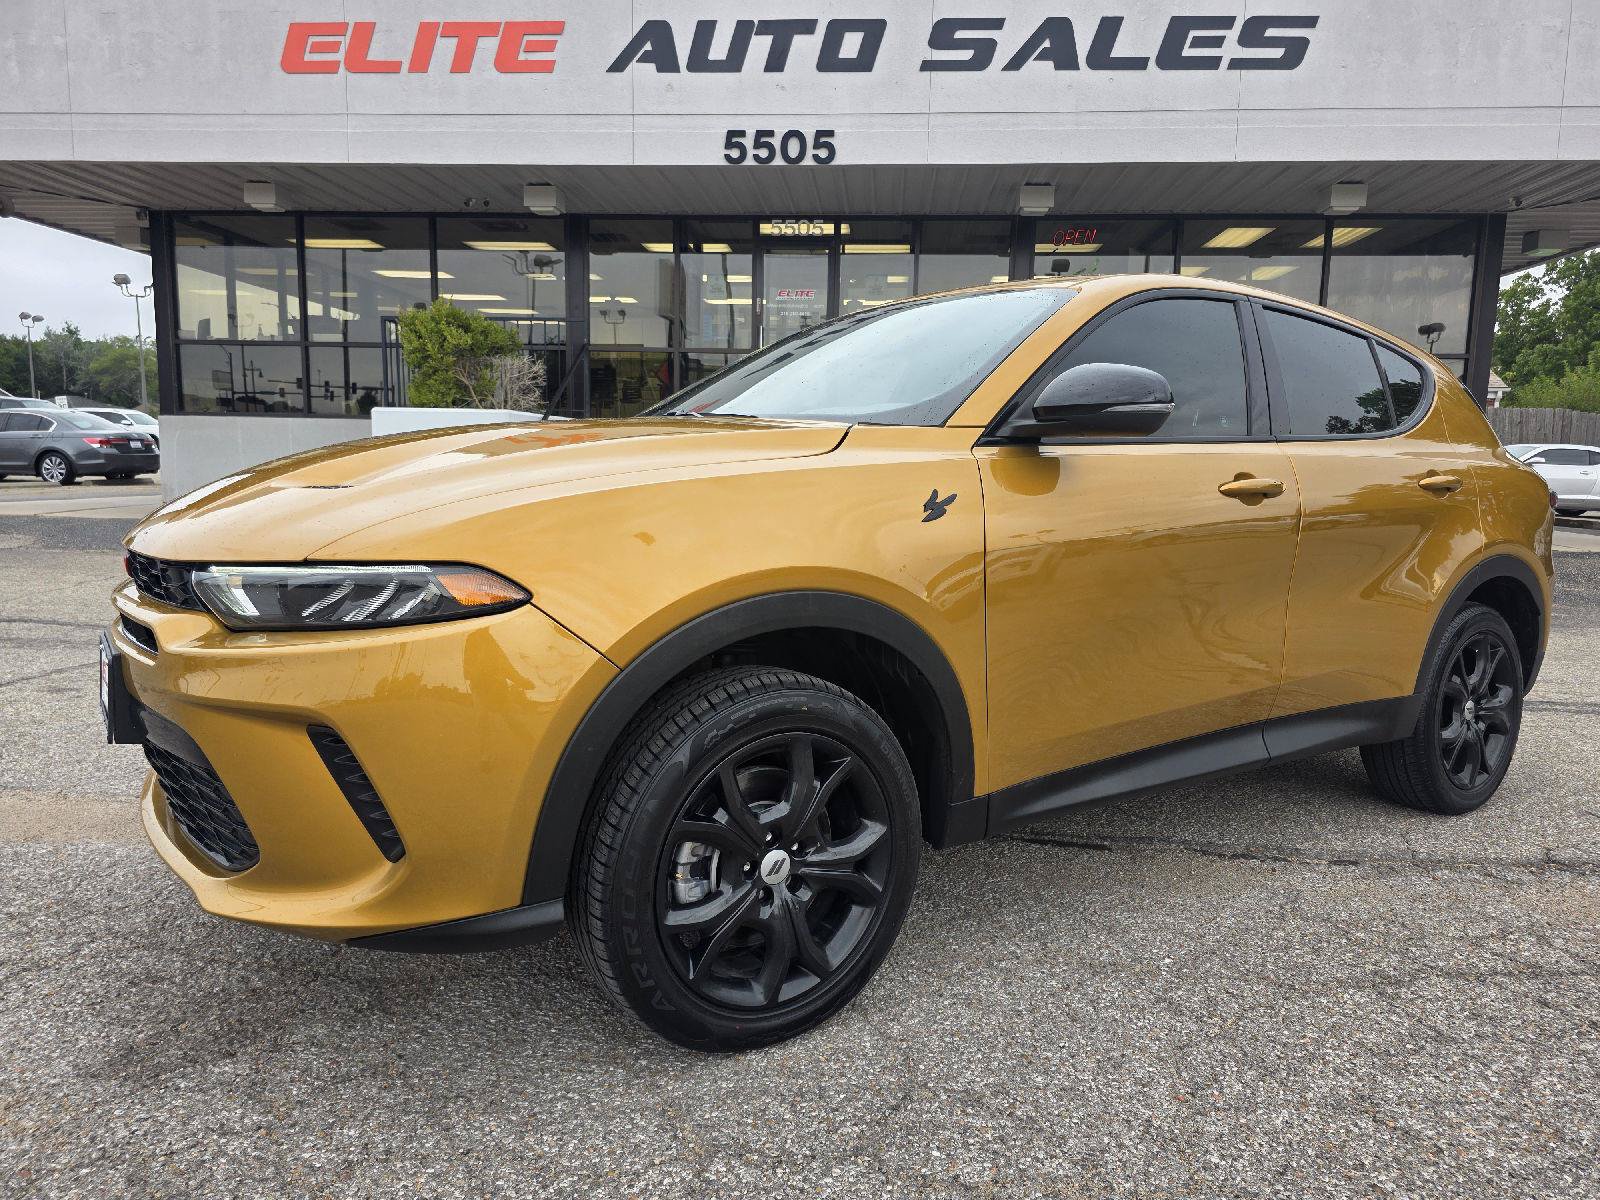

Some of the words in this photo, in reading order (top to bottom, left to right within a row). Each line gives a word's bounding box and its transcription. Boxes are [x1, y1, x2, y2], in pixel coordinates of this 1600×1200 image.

[280, 20, 565, 74] ELITE
[605, 18, 888, 73] AUTO
[918, 15, 1320, 72] SALES
[724, 129, 836, 165] 5505
[770, 219, 824, 237] 5505
[1053, 229, 1097, 246] OPEN
[776, 289, 816, 298] ELITE
